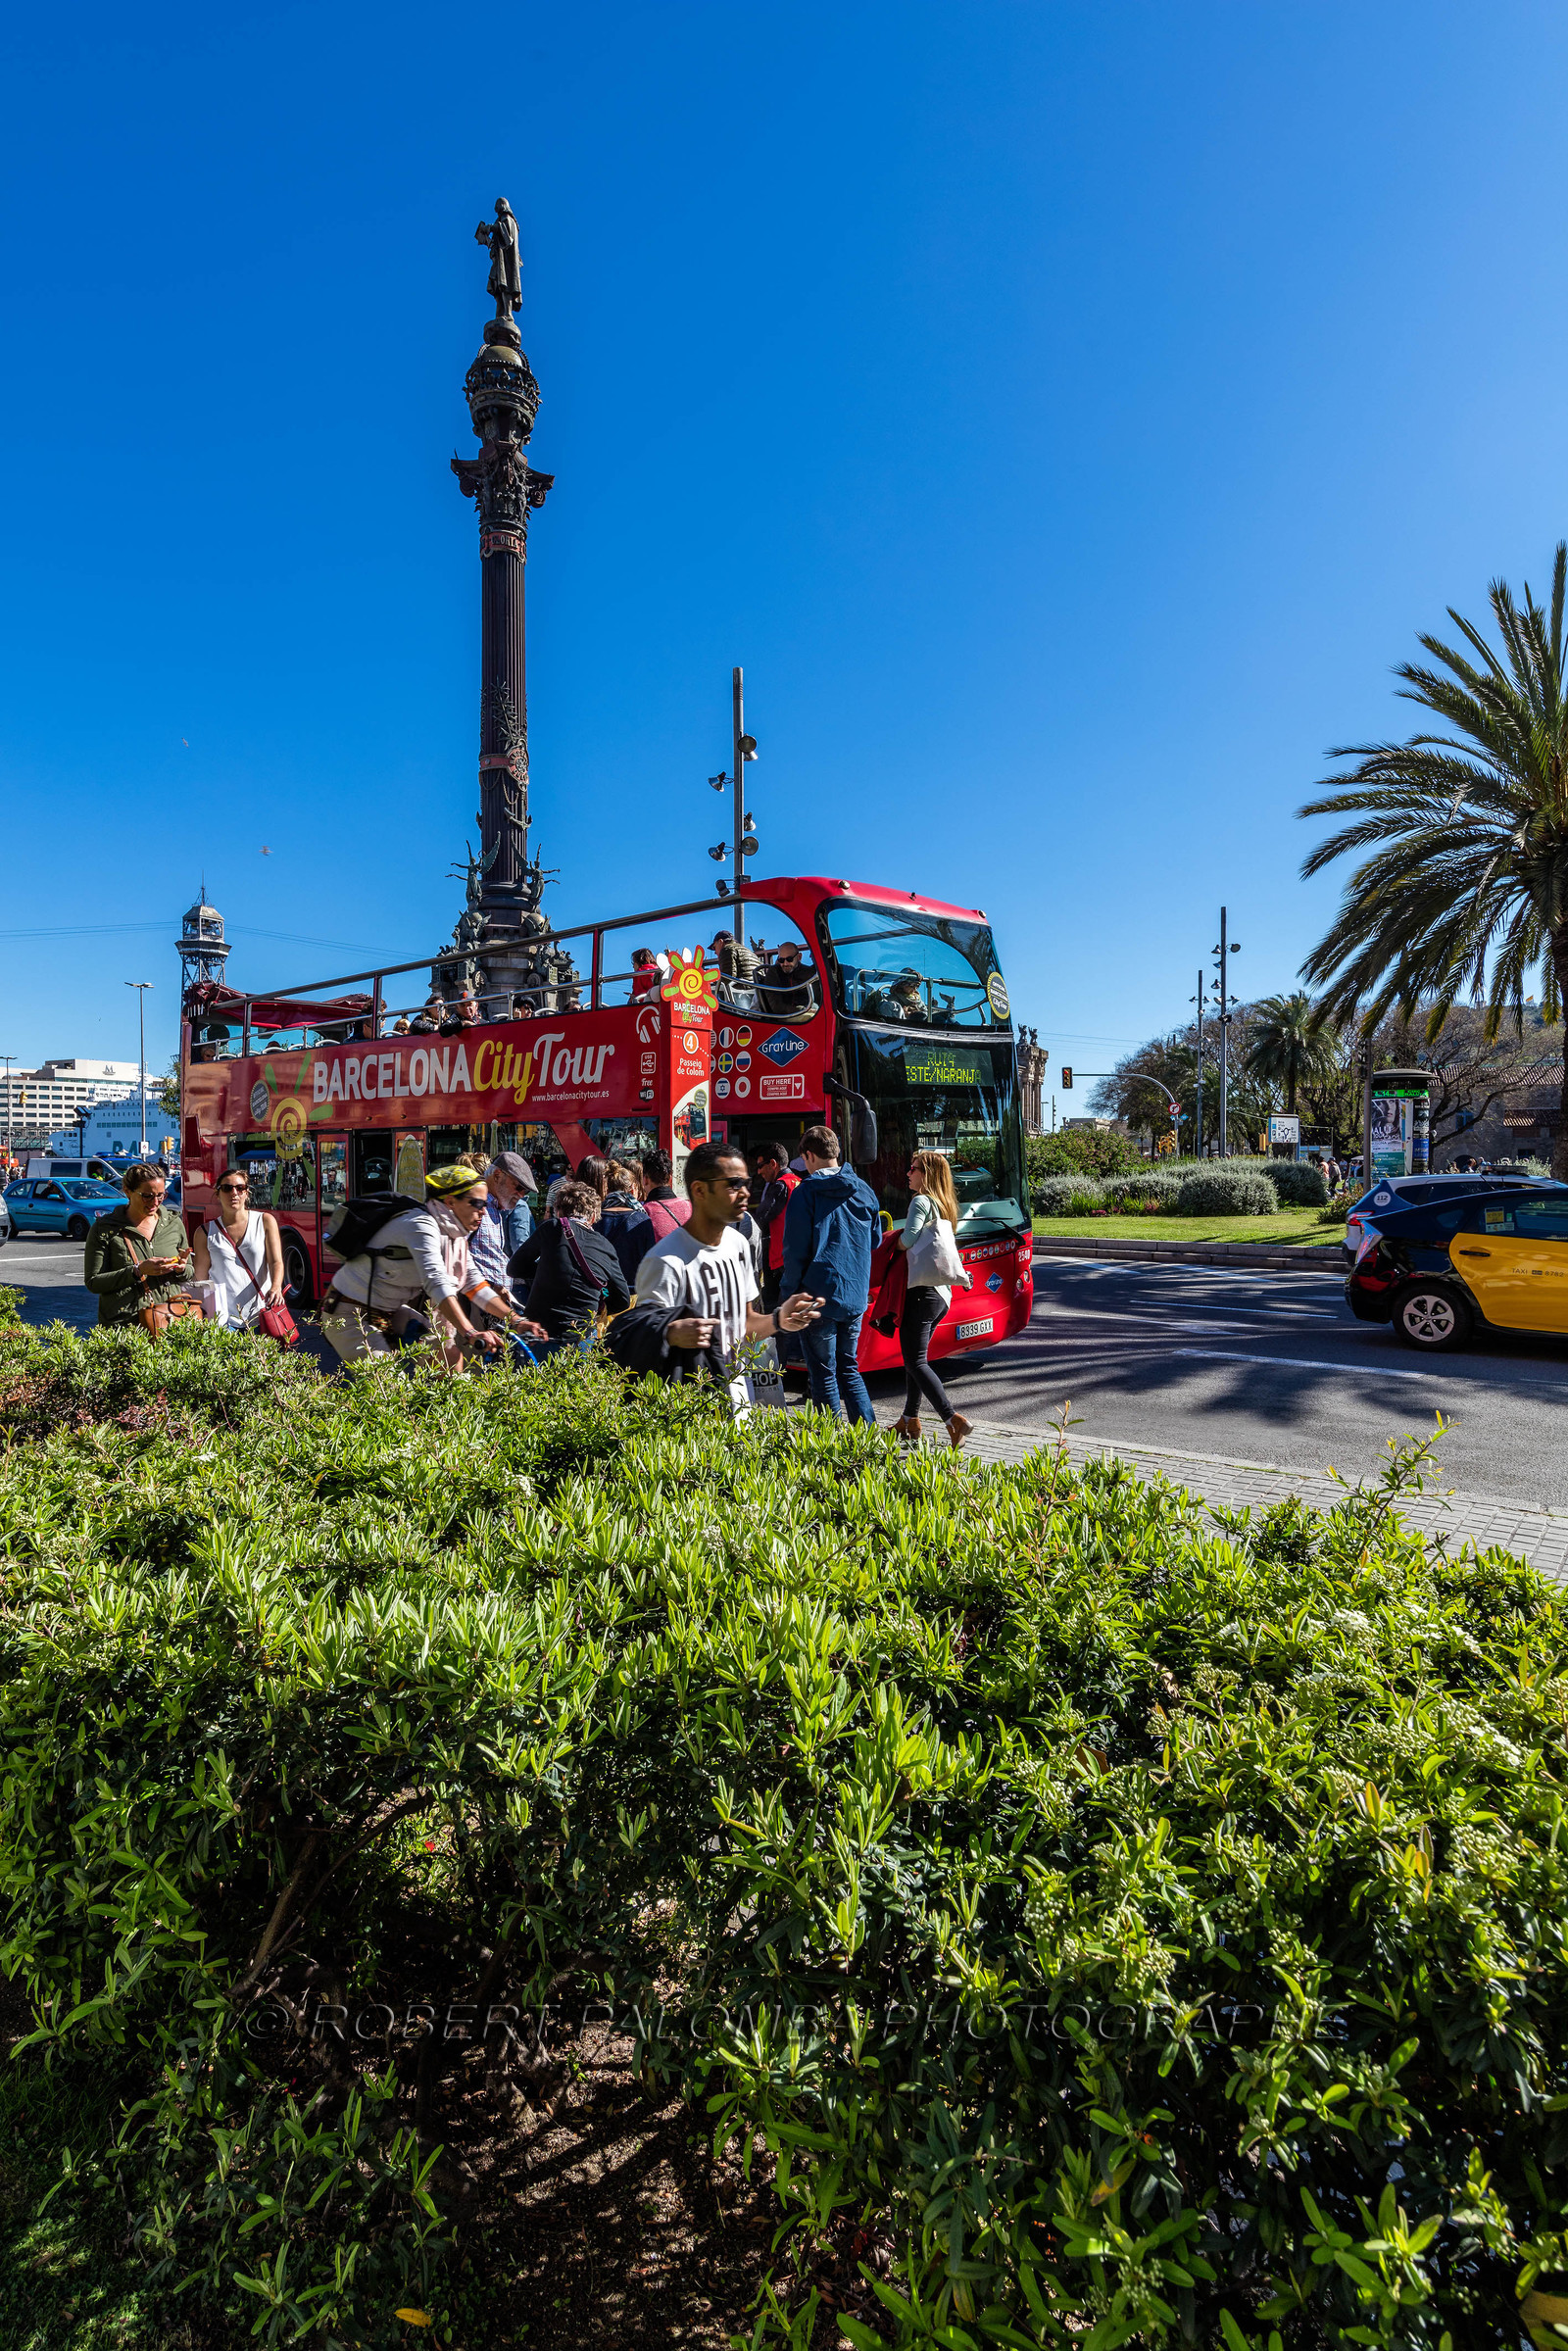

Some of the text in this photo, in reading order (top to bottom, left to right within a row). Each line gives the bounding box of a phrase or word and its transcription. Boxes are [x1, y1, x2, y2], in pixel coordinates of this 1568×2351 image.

[673, 1002, 710, 1015] BARCELONA
[686, 1035, 694, 1050] 4
[313, 1032, 614, 1104] BARCELONA City Tour
[679, 1057, 703, 1070] Passeig
[676, 1067, 705, 1077] de Colom
[532, 1089, 610, 1102] www.barcelonacitytour.es
[960, 1320, 992, 1338] 8339 GXX
